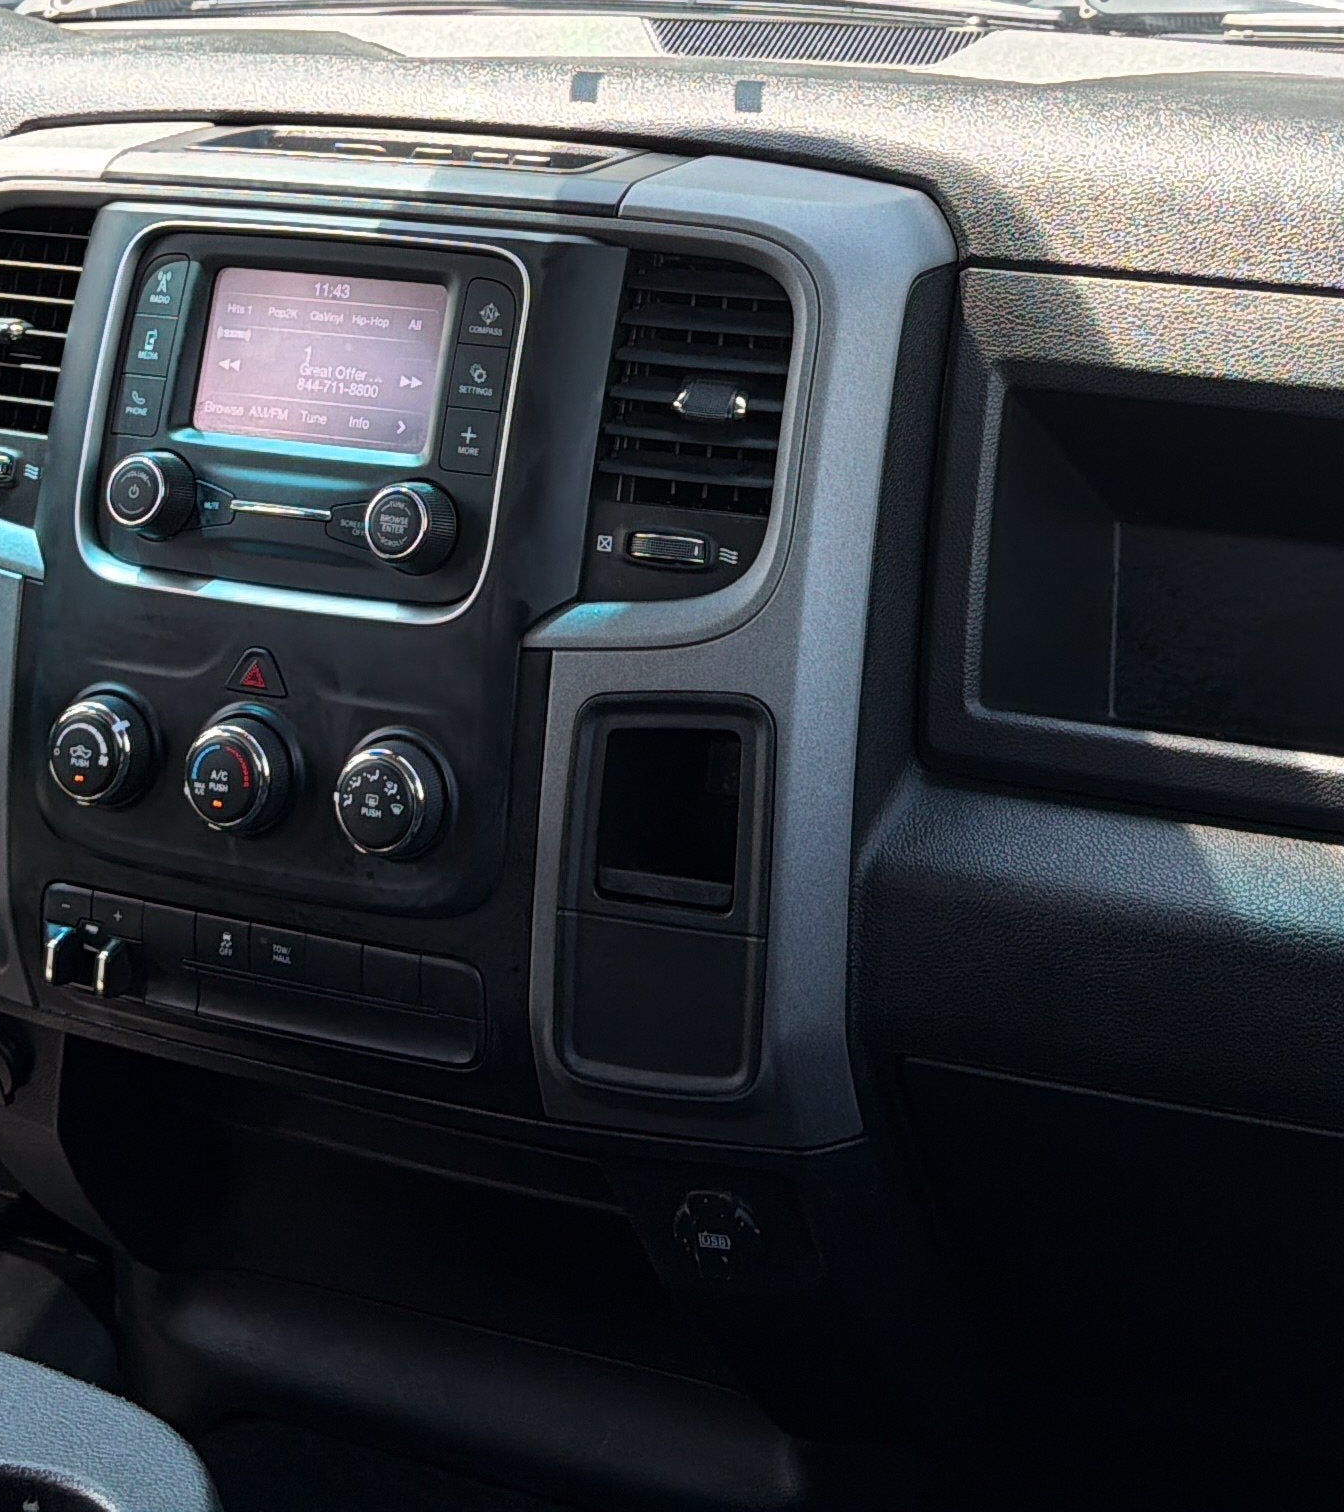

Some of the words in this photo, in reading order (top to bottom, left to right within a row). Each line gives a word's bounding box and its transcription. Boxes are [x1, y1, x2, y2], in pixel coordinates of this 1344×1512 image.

[314, 282, 351, 299] 11:43
[149, 294, 171, 305] RADIO
[227, 303, 245, 314] Hits
[247, 305, 253, 315] 1
[268, 306, 298, 319] Pop2K
[352, 315, 390, 328] Hip-Hop
[408, 320, 422, 330] All
[468, 324, 503, 337] COMPASS
[137, 350, 159, 360] MEDIA
[304, 346, 312, 366] 1
[299, 363, 332, 377] Great
[336, 366, 367, 381] Offer
[296, 377, 379, 398] 844-711-8800
[458, 385, 493, 397] SETTINGS
[125, 406, 148, 416] PHONE
[204, 400, 244, 416] Browse
[249, 406, 289, 421] AM/FM
[301, 410, 327, 425] Tune
[348, 416, 370, 430] Info
[457, 446, 479, 457] MORE
[379, 513, 409, 525] BROWSE
[382, 524, 405, 535] ENTER
[70, 757, 90, 768] PUSH
[210, 769, 229, 781] A/C
[209, 781, 229, 793] PUSH
[361, 806, 382, 819] PUSH
[218, 947, 233, 957] OFF
[272, 953, 292, 965] HAUL
[700, 1236, 727, 1248] USB
